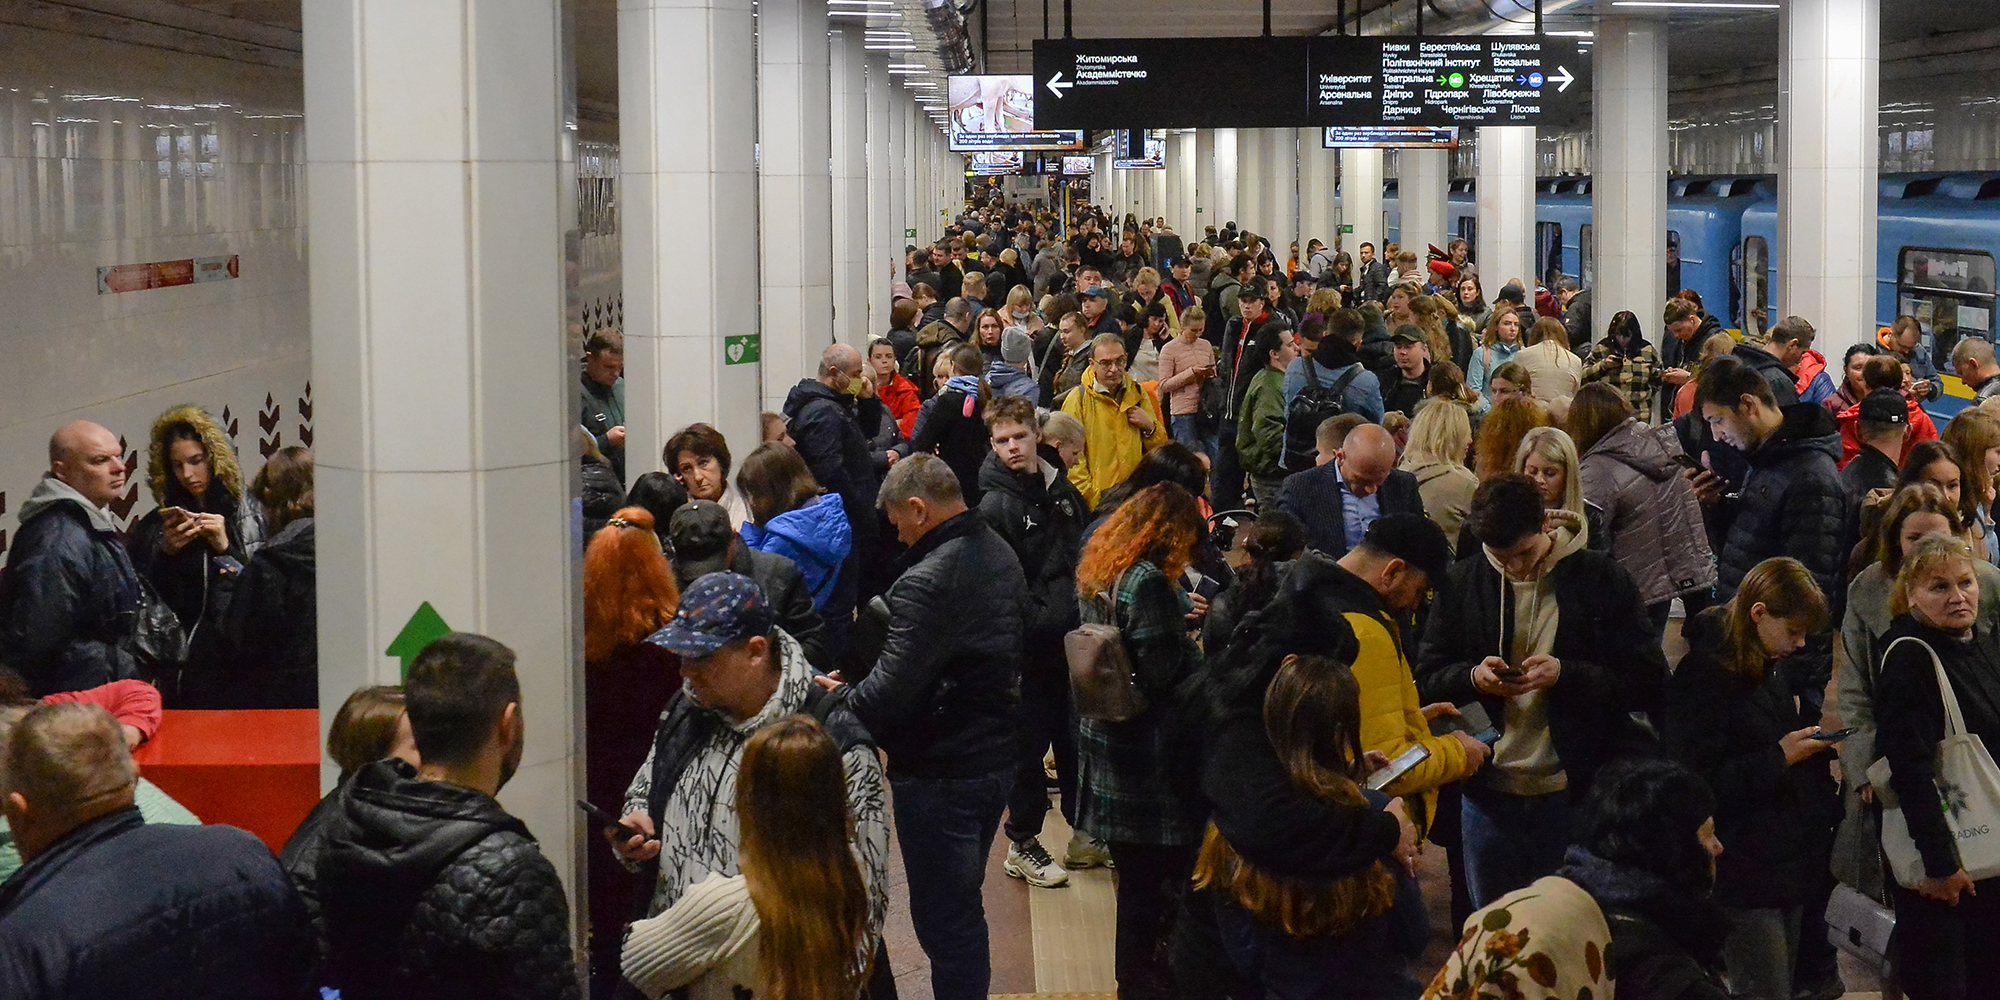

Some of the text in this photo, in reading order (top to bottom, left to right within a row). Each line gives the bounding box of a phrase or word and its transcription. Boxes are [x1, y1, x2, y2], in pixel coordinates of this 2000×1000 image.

[1382, 42, 1410, 52] Нивки
[1420, 42, 1480, 52] Берестейська
[1491, 42, 1540, 52] Шулявська
[1075, 54, 1138, 64] Житомирська
[1382, 58, 1480, 68] Політехнічний Інститут
[1493, 58, 1540, 66] Вокзальна
[1075, 70, 1148, 80] Академмістечко
[1319, 74, 1372, 84] Університет
[1382, 74, 1434, 84] Театральна
[1469, 74, 1514, 82] Хрещатик
[1319, 90, 1372, 100] Арсенальна
[1382, 90, 1414, 100] Дніпро
[1424, 90, 1468, 98] Гідропарк
[1482, 90, 1540, 98] Лівобережна
[1382, 106, 1422, 114] Дарниця
[1441, 106, 1496, 114] Чернігівська
[1510, 106, 1540, 114] Лісова
